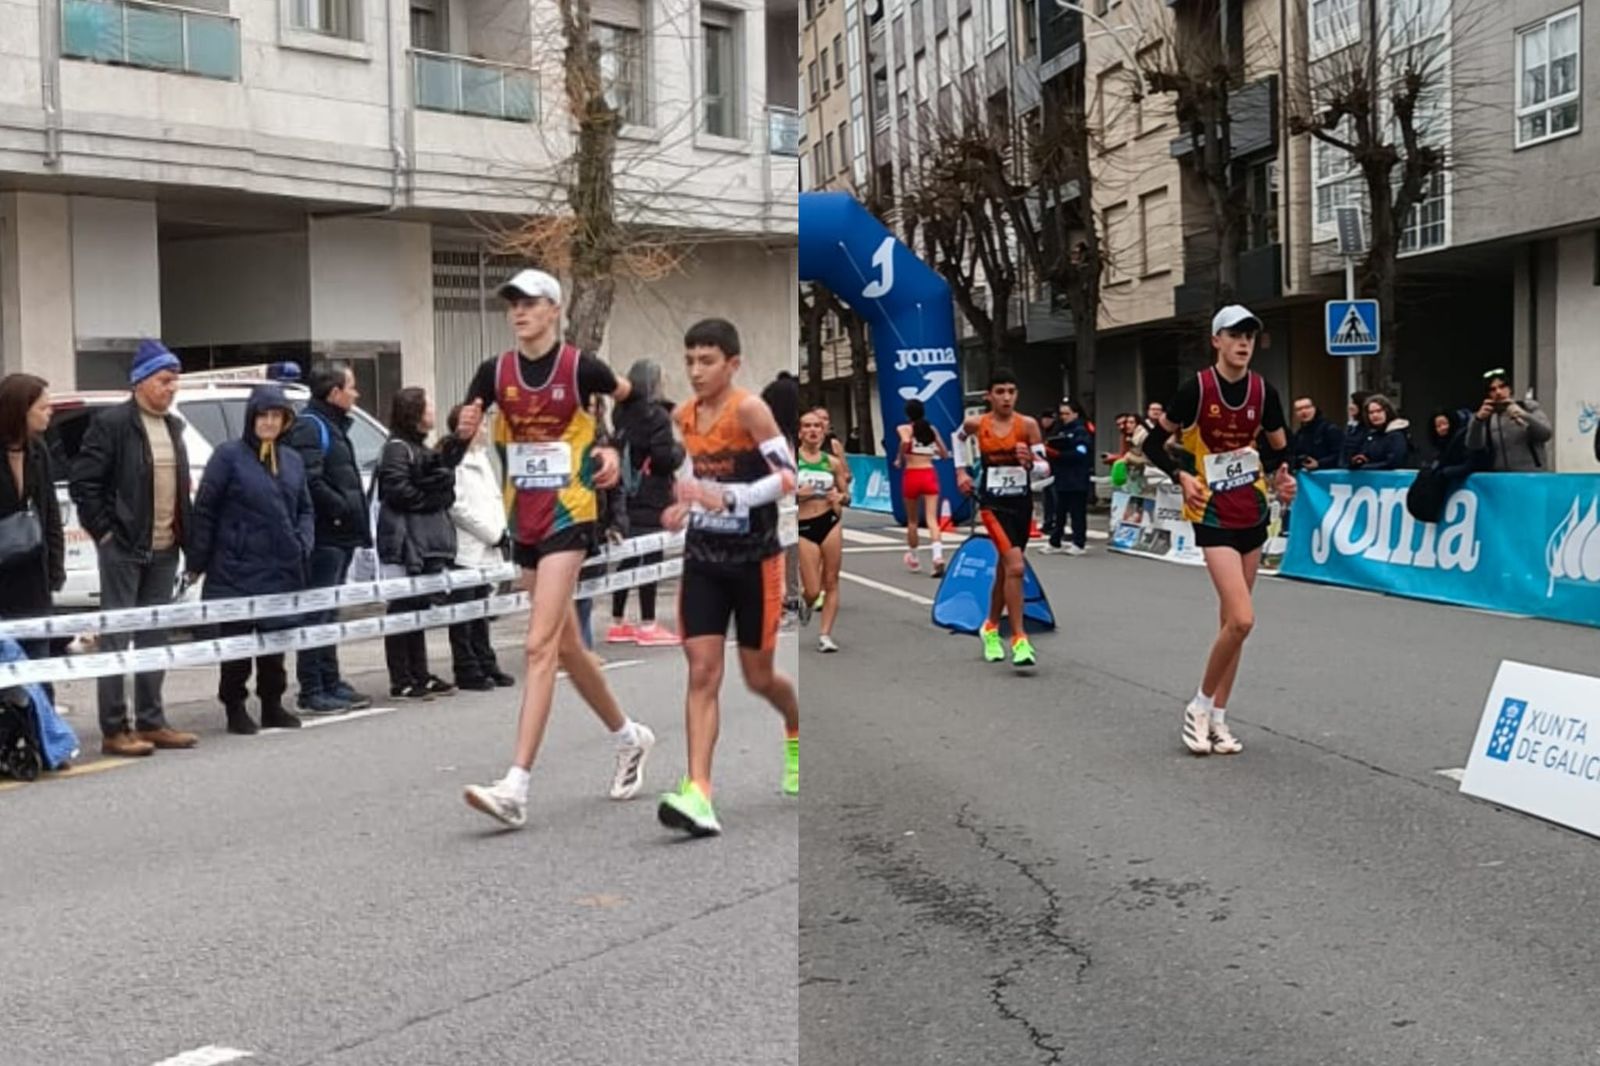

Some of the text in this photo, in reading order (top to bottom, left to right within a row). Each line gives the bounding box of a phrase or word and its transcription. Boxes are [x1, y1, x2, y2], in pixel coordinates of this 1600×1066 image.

[526, 458, 548, 474] 64
[1226, 462, 1242, 478] 64
[1002, 476, 1016, 488] 75
[1527, 710, 1588, 745] XUNTA
[1516, 738, 1542, 764] DE
